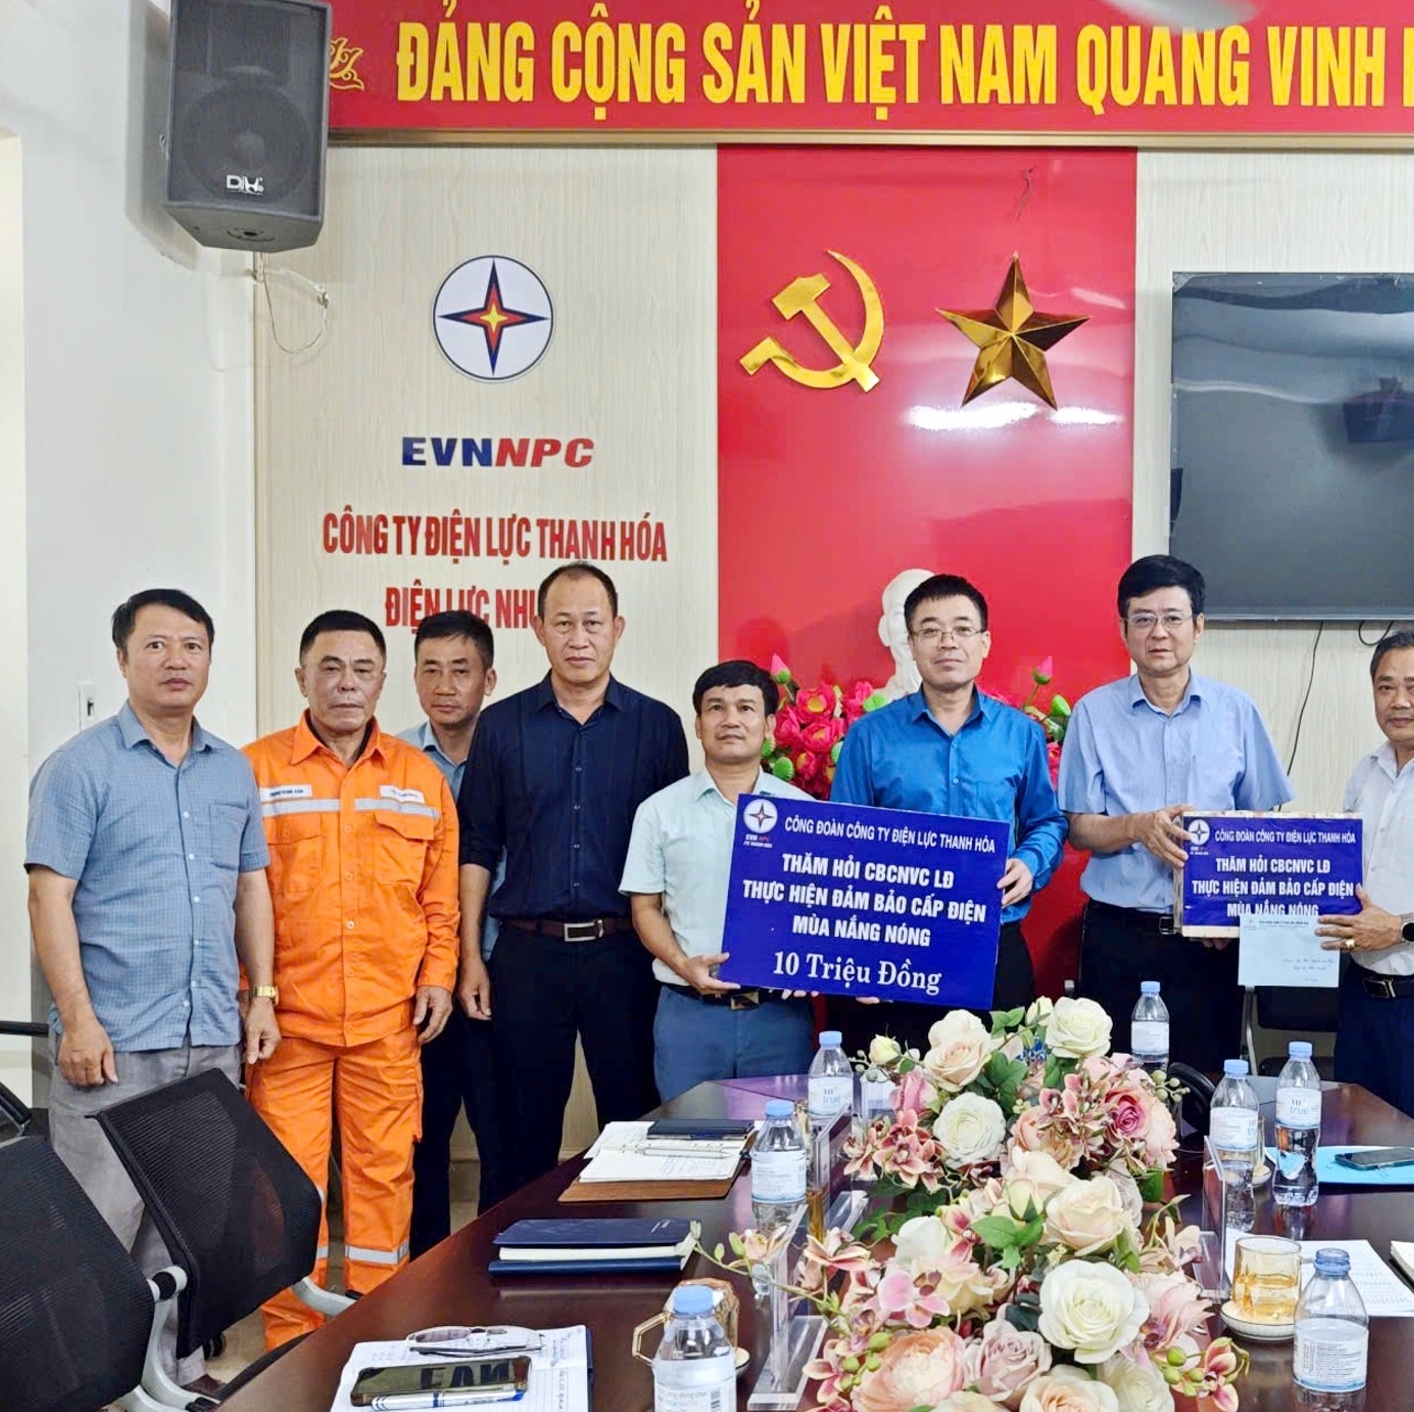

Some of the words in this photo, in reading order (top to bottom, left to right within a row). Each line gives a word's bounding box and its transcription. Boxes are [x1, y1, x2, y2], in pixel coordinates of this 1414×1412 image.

[396, 0, 534, 102] ĐẢNG
[551, 2, 685, 120] CỘNG
[701, 0, 806, 104] SẢN
[820, 5, 926, 120] VIỆT
[939, 24, 1057, 104] NAM
[1075, 23, 1250, 115] QUANG
[1267, 25, 1386, 107] VINH
[323, 504, 388, 555] CÔNG
[392, 515, 422, 556] TY
[424, 509, 481, 564] ĐIỆN
[486, 513, 532, 565] LỰC
[536, 518, 616, 561] THANH
[619, 511, 668, 562] HÓA
[385, 579, 441, 634] ĐIỆN
[784, 814, 814, 834] CÔNG
[816, 817, 845, 836] ĐOÀN
[846, 820, 875, 840] CÔNG
[877, 826, 891, 842] TY
[892, 826, 916, 846] ĐIỆN
[917, 829, 937, 848] LỰC
[939, 834, 973, 851] THANH
[974, 833, 996, 853] HÓA
[1214, 828, 1235, 843] CÔNG
[1235, 828, 1255, 843] ĐOÀN
[1256, 828, 1275, 844] CÔNG
[1276, 831, 1285, 843] TY
[1285, 829, 1301, 845] ĐIỆN
[1302, 830, 1317, 845] LỰC
[1318, 832, 1342, 844] THANH
[782, 851, 828, 876] THĂM
[832, 856, 860, 879] HỎI
[864, 862, 930, 885] CBCNVC
[933, 870, 955, 889] LĐ
[1215, 855, 1246, 873] THĂM
[1249, 854, 1267, 873] HỎI
[1270, 858, 1315, 874] CBCNVC
[1316, 859, 1331, 874] LĐ
[742, 879, 785, 904] THỰC
[788, 882, 829, 908] HIỆN
[831, 884, 870, 910] ĐẢM
[873, 888, 908, 914] BẢO
[911, 892, 944, 918] CẤP
[946, 899, 987, 924] ĐIỆN
[1191, 878, 1220, 898] THỰC
[1222, 878, 1248, 899] HIỆN
[1250, 877, 1276, 896] ĐẢM
[1278, 877, 1301, 896] BẢO
[1303, 877, 1326, 897] CẤP
[1328, 879, 1354, 900] ĐIỆN
[1226, 901, 1252, 917] MÙA
[1254, 898, 1286, 915] NẮNG
[1288, 901, 1319, 916] NÓNG
[792, 914, 830, 937] MÙA
[834, 915, 881, 942] NẮNG
[884, 922, 931, 947] NÓNG
[773, 951, 800, 975] 10
[806, 953, 871, 988] Triệu
[878, 957, 943, 996] Đồng
